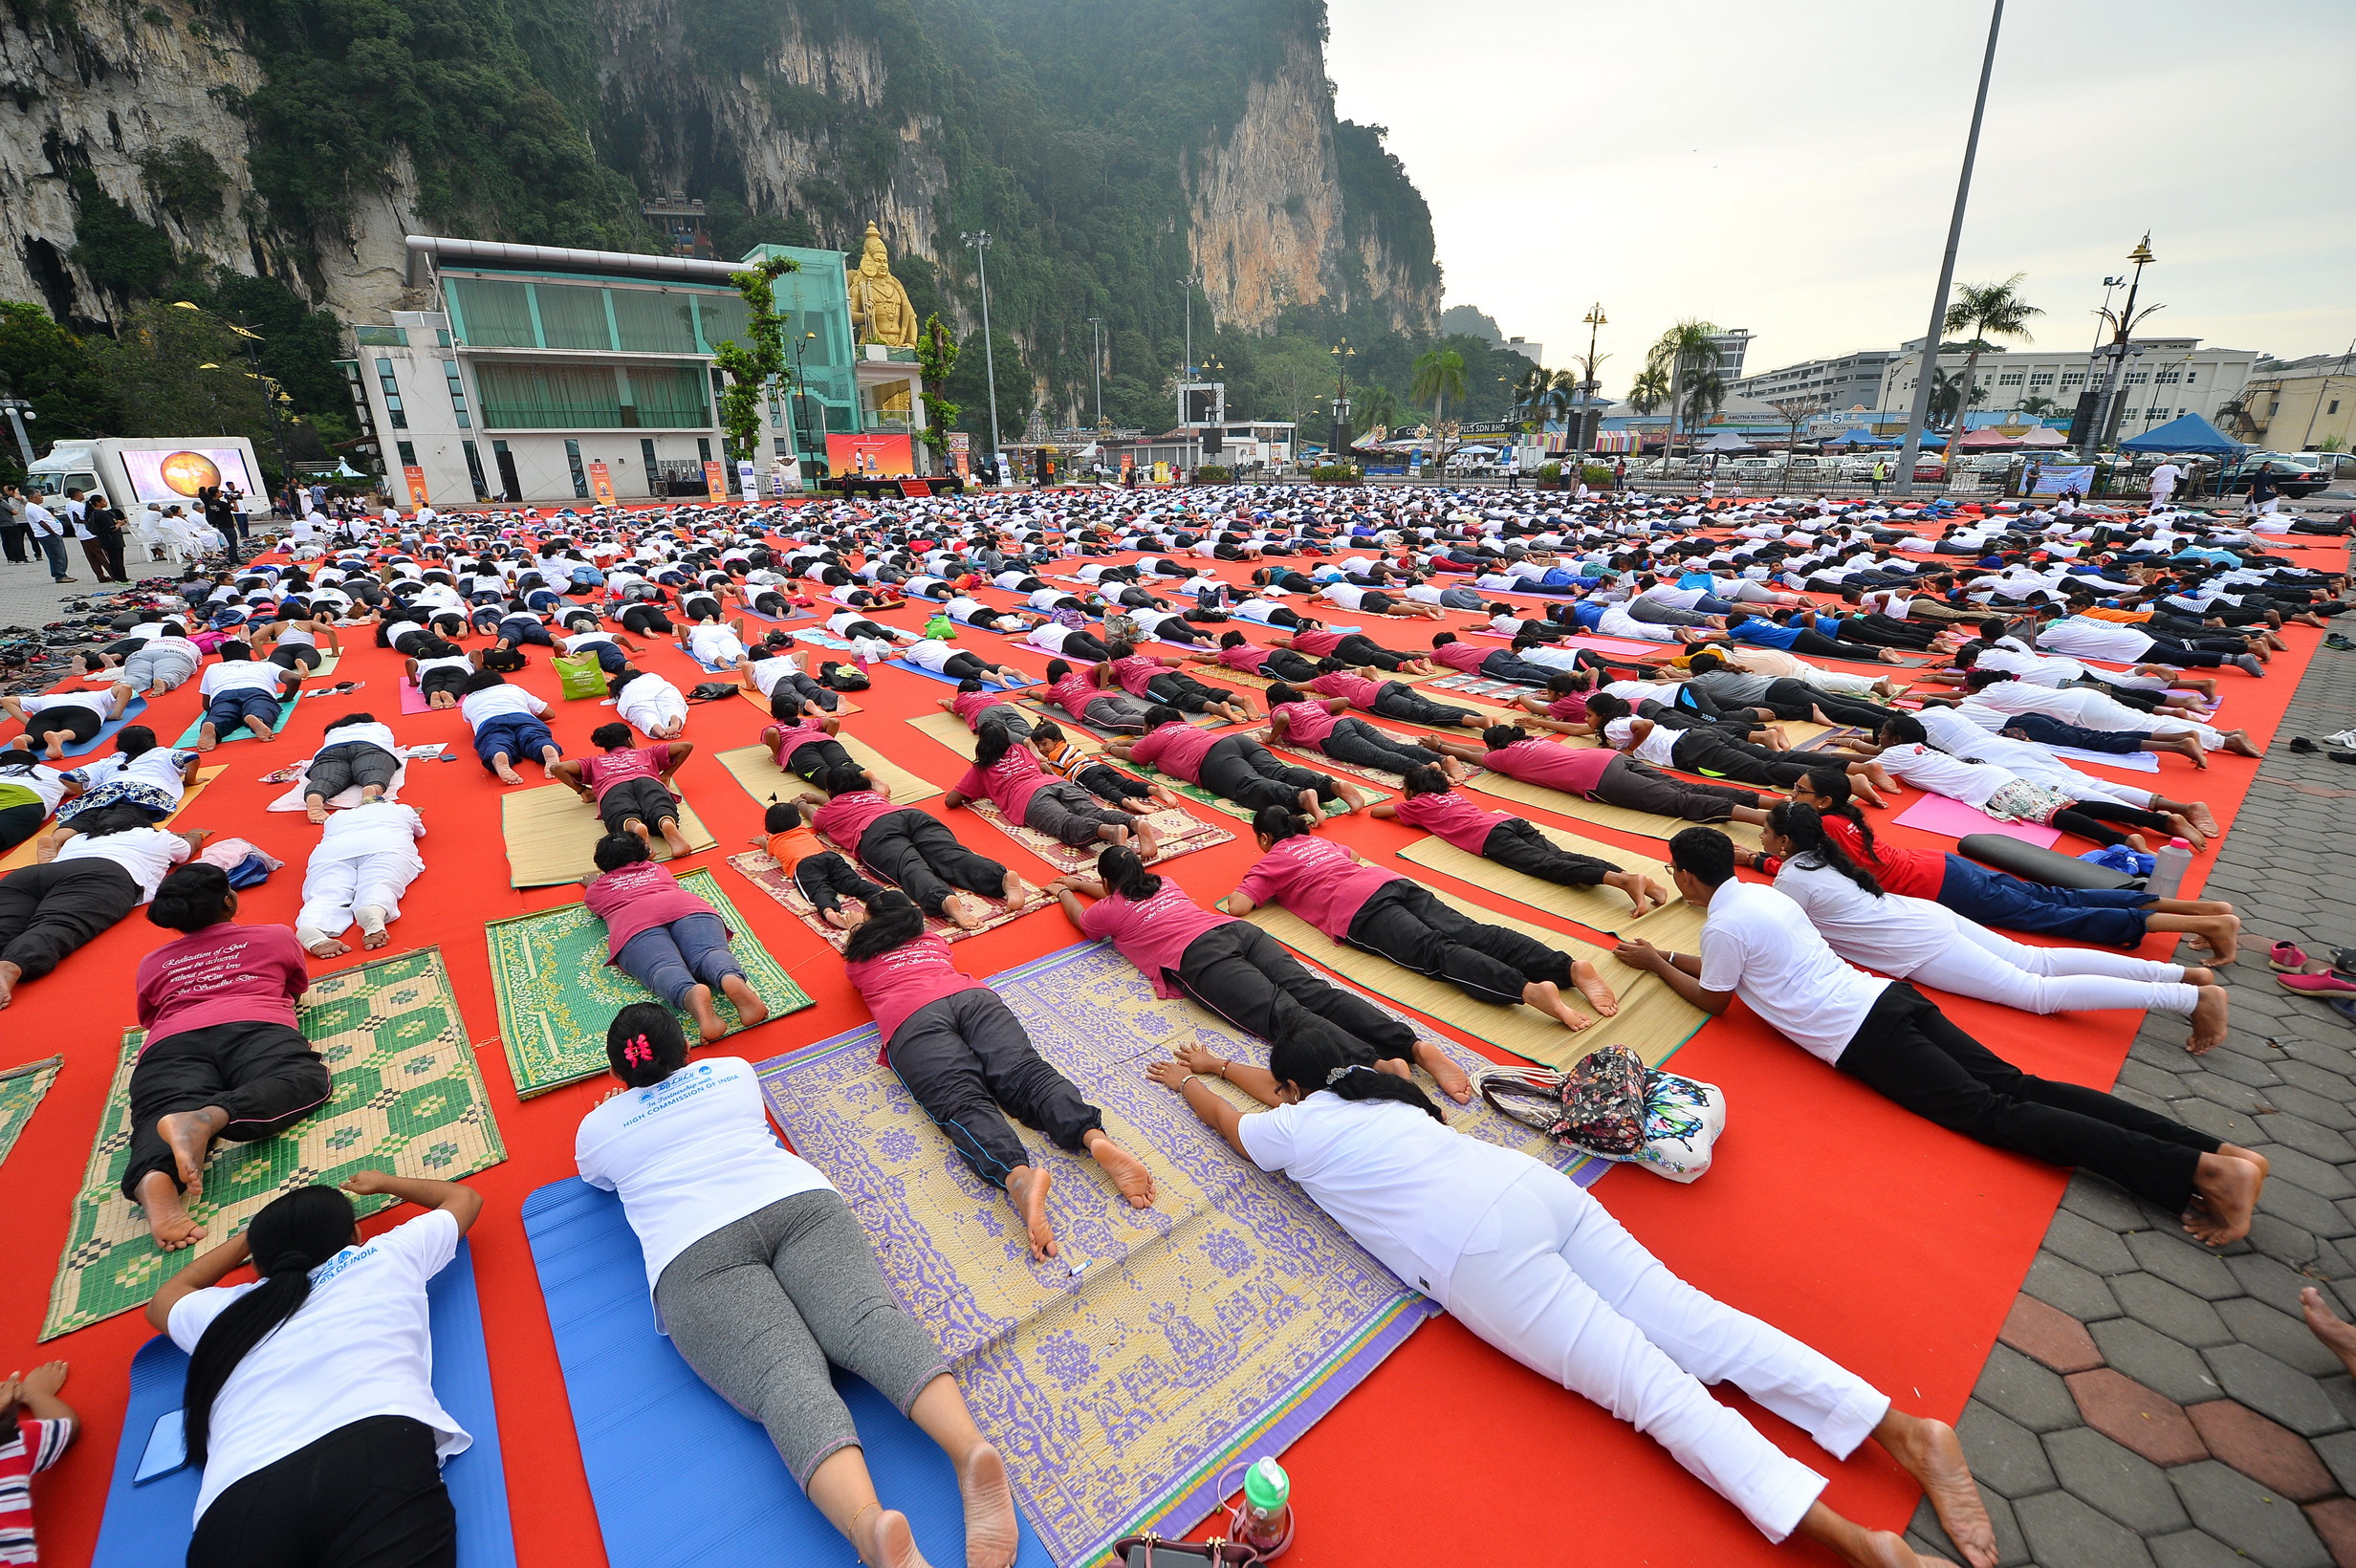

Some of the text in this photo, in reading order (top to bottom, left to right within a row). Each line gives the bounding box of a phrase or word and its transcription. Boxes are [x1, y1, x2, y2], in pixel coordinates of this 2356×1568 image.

[1833, 415, 1842, 424] 5
[1475, 425, 1490, 433] SDN
[1492, 424, 1505, 432] BHD
[213, 947, 224, 956] of
[223, 942, 248, 954] God
[206, 952, 240, 966] achieved
[170, 972, 197, 983] without
[197, 973, 224, 983] Him
[671, 1072, 694, 1085] LuLu
[647, 1100, 656, 1109] In
[657, 1082, 698, 1103] Partnership
[698, 1077, 712, 1085] with
[622, 1113, 645, 1128] HIGH
[646, 1086, 705, 1116] COMMISSION
[705, 1080, 716, 1089] OF
[717, 1074, 739, 1085] INDIA
[336, 1247, 379, 1273] OF INDIA
